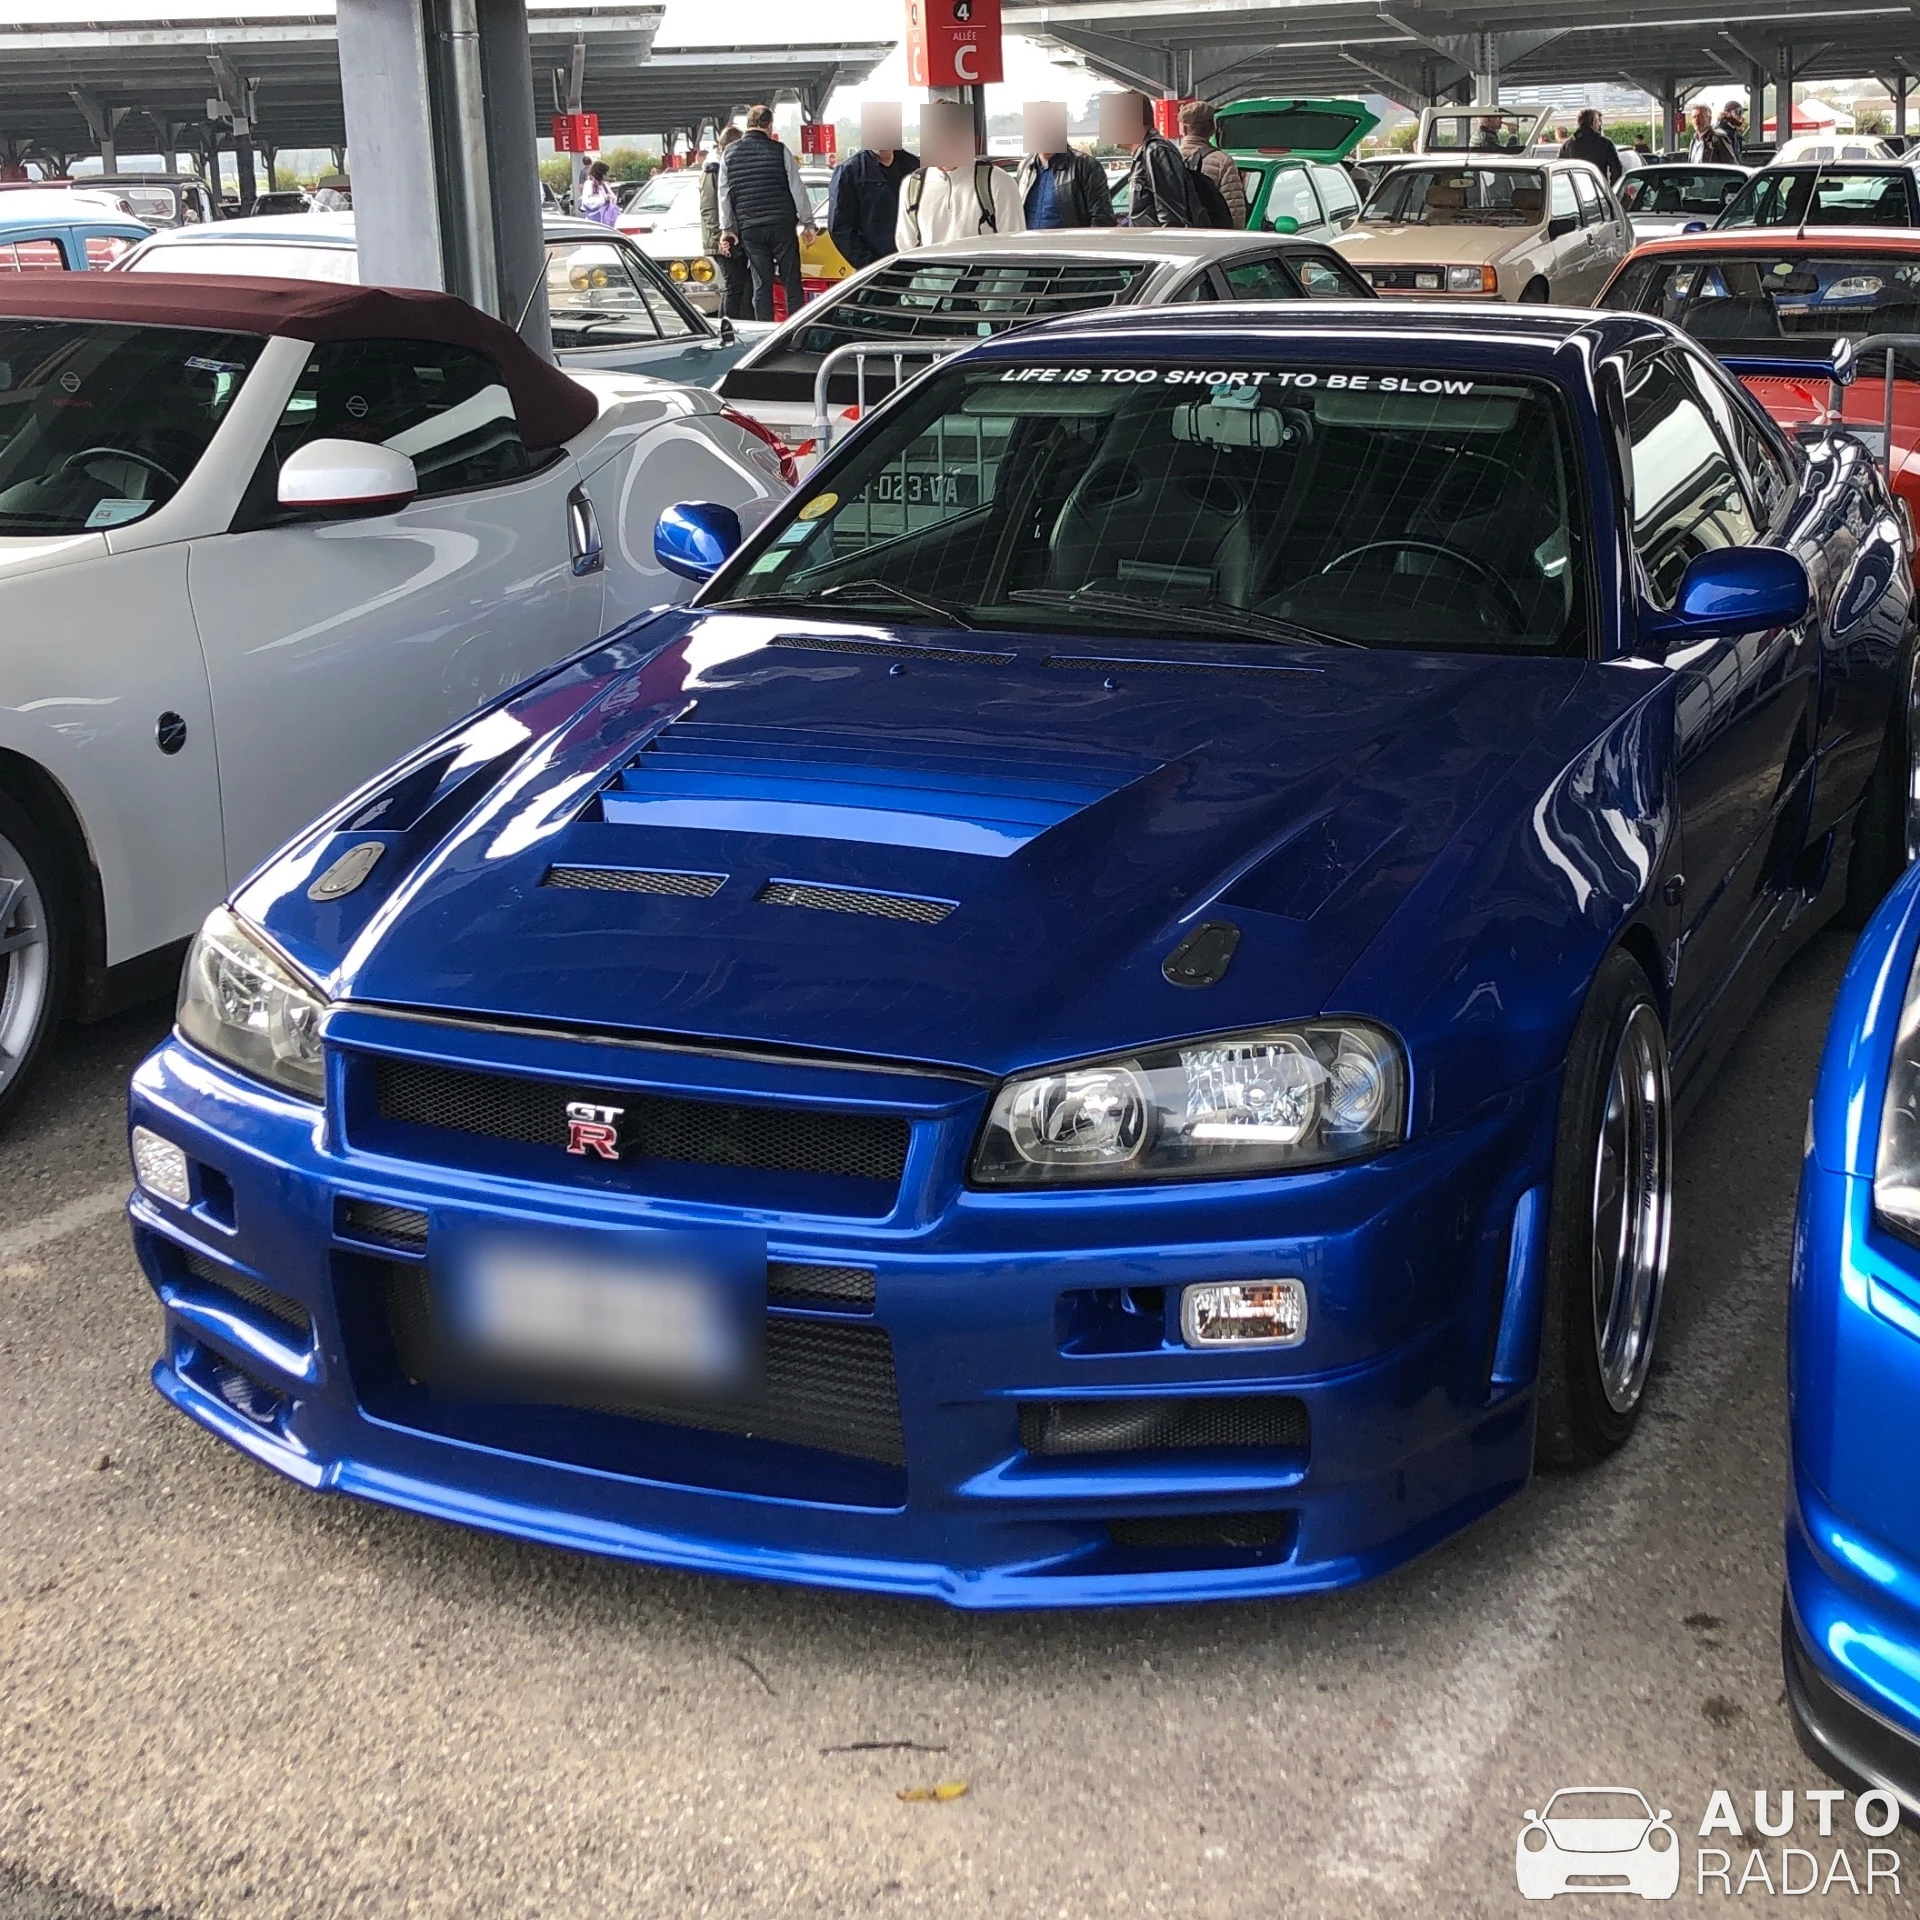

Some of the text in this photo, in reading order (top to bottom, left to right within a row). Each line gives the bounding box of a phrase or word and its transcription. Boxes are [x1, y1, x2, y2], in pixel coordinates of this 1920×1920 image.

[957, 4, 969, 20] 4
[952, 30, 977, 41] ALLÉE
[954, 44, 979, 80] C
[563, 136, 570, 150] E
[585, 135, 592, 149] E
[809, 141, 814, 152] F
[1000, 368, 1475, 395] LIFE IS TOO SHORT TO BE SLOW
